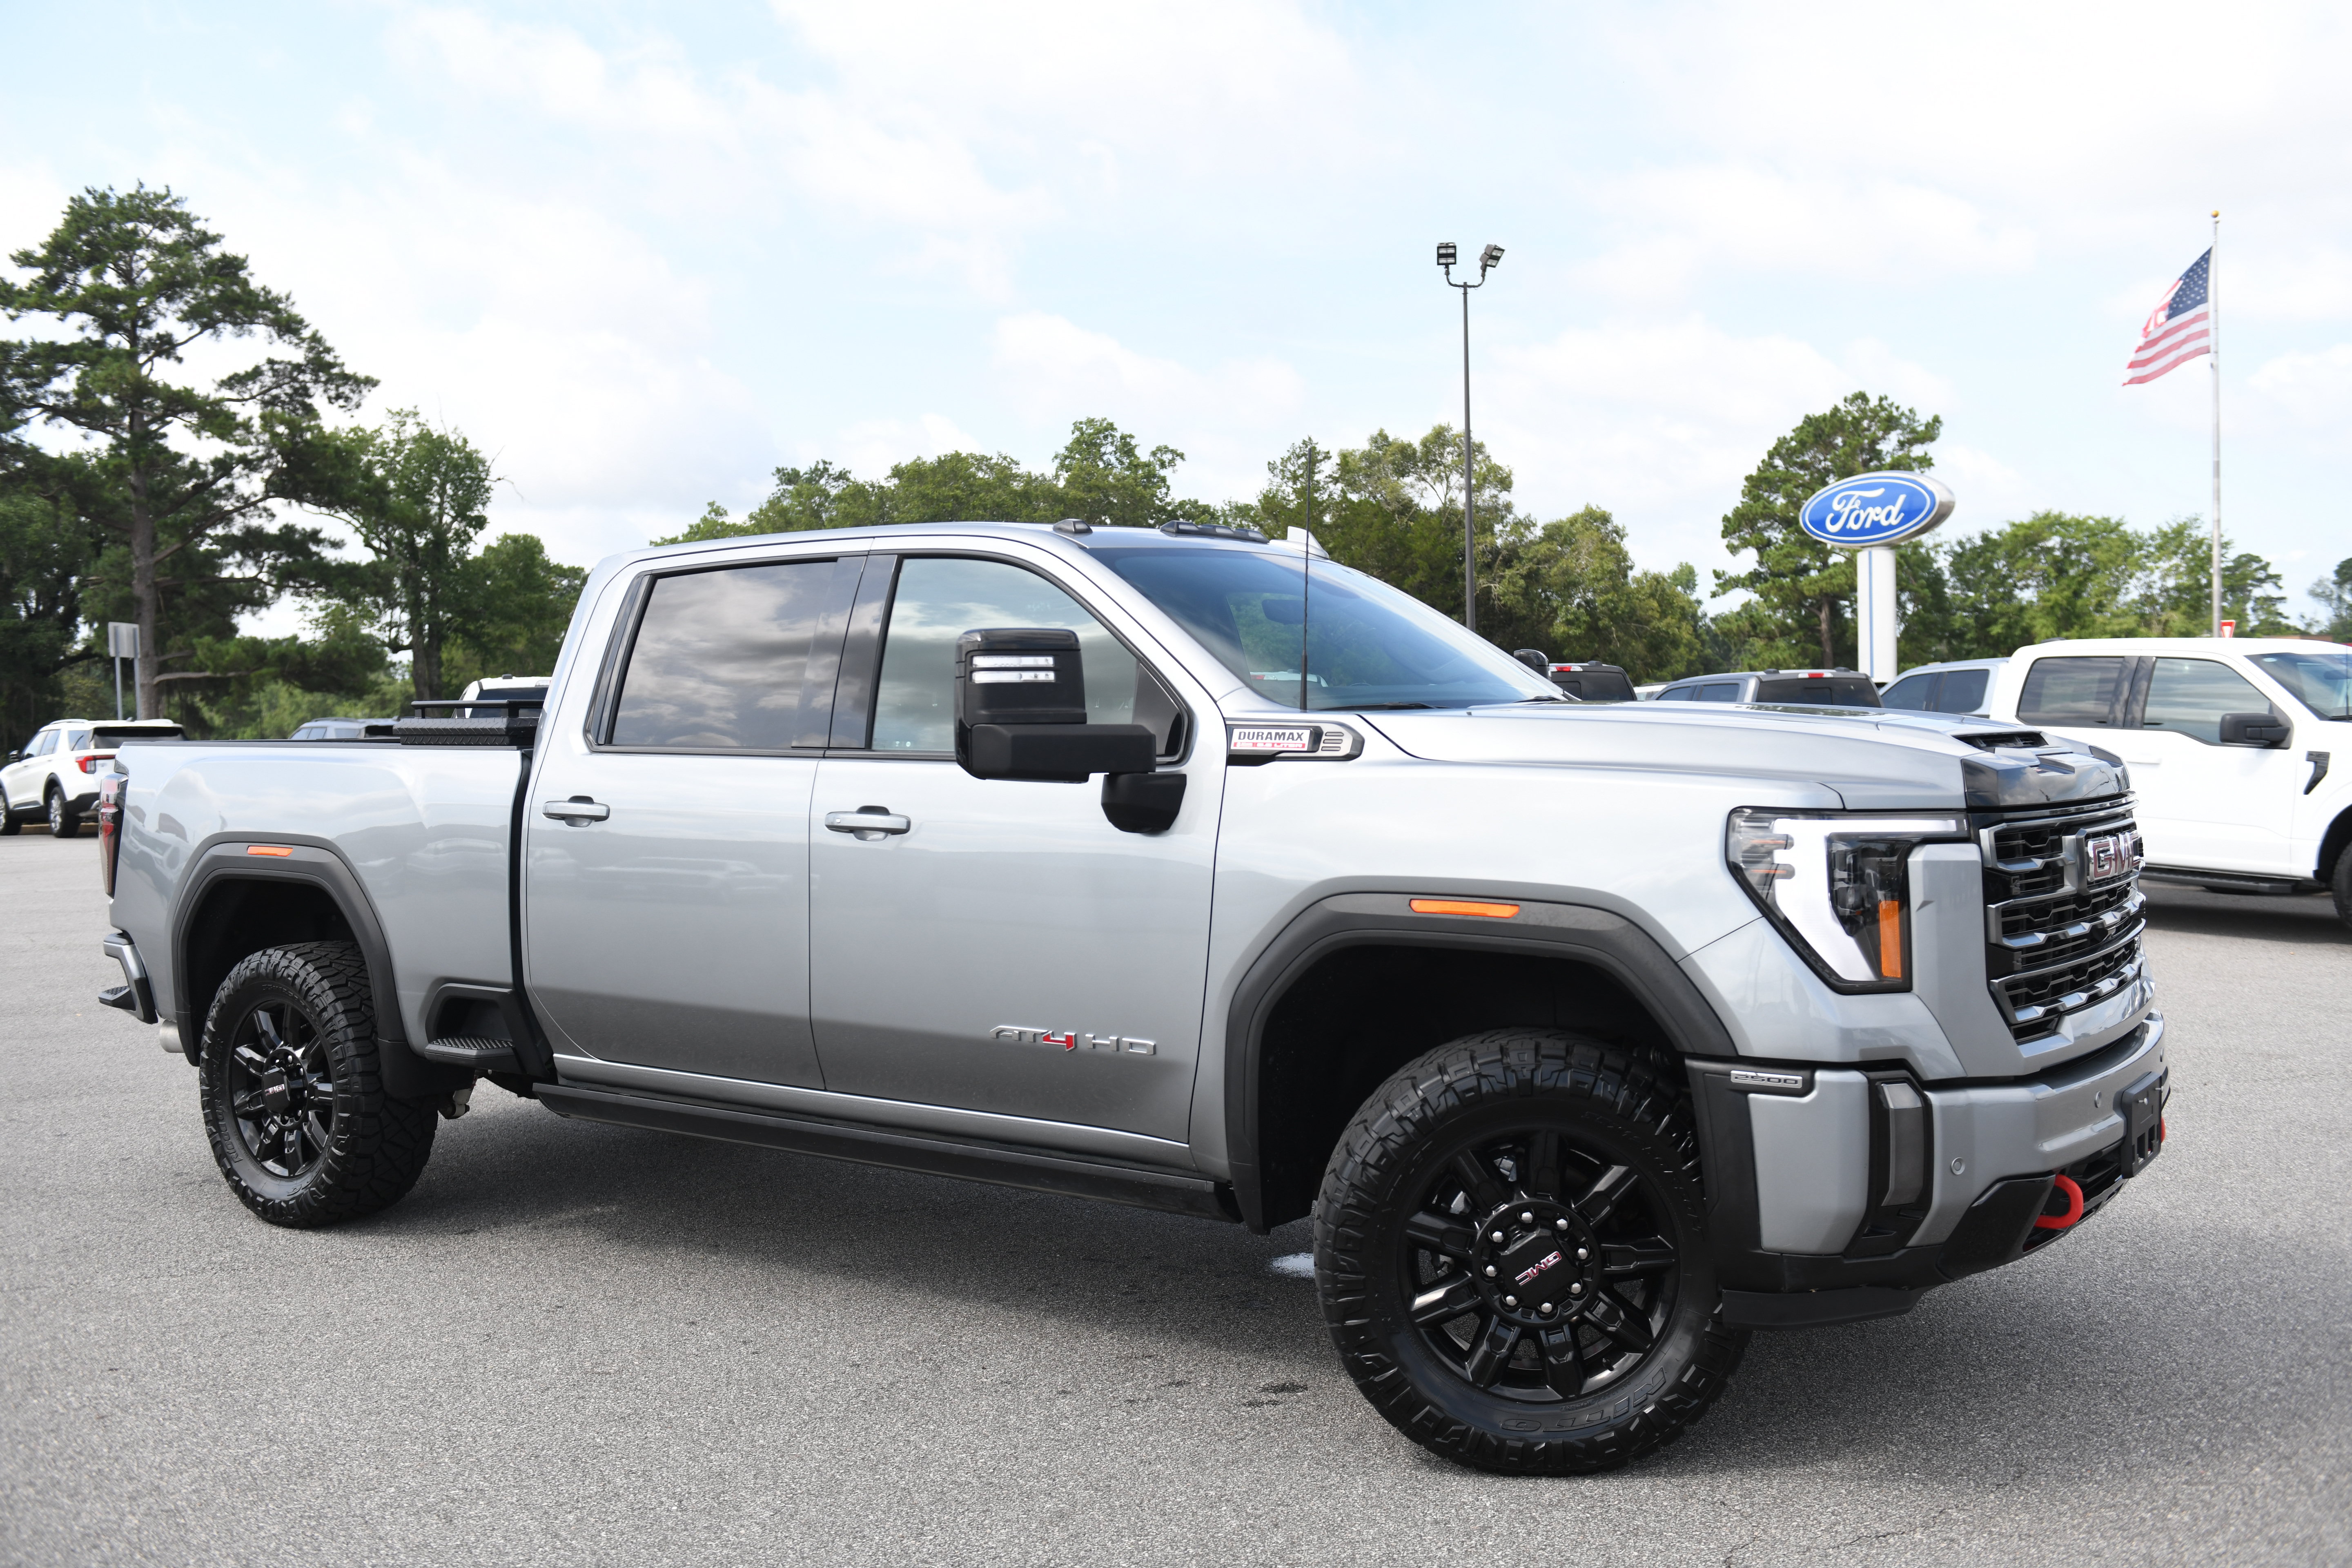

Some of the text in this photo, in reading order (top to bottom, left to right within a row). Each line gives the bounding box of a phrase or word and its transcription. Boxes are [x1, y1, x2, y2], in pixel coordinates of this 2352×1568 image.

[1826, 488, 1906, 533] Ford
[1238, 731, 1304, 741] DURAMAX
[2087, 830, 2144, 882] GMC
[990, 1025, 1156, 1055] AT4 HD
[265, 1084, 285, 1096] GMC
[1735, 1074, 1798, 1085] 2500
[1515, 1251, 1562, 1286] GMC
